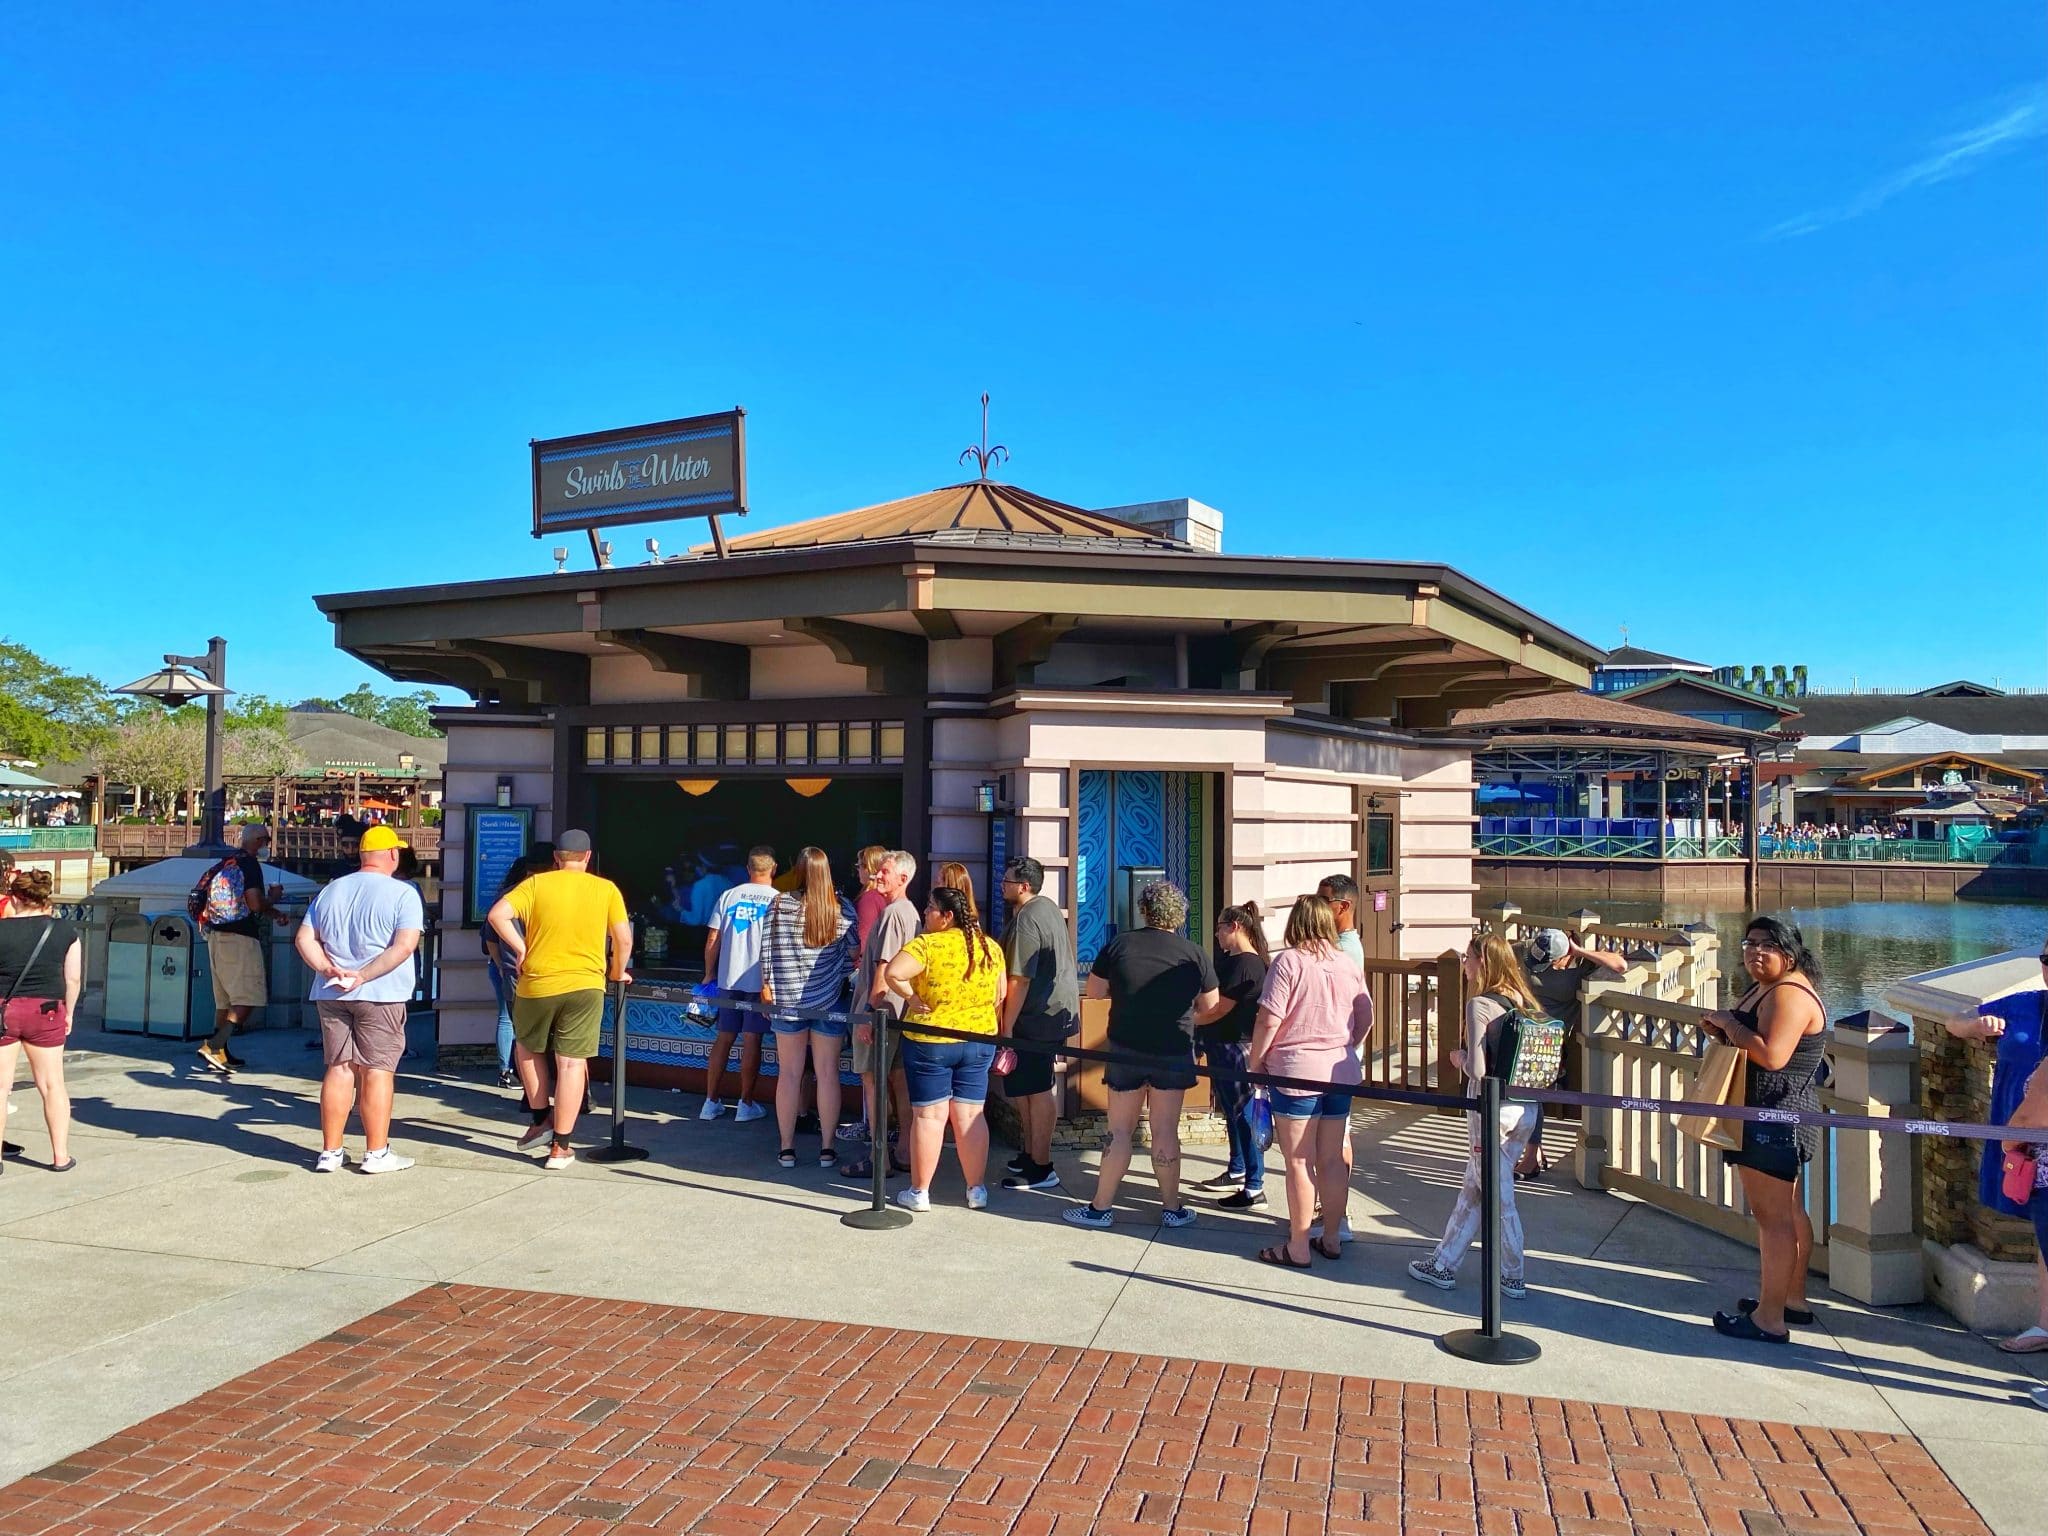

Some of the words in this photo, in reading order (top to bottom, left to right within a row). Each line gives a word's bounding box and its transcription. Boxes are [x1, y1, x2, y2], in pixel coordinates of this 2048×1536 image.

[564, 460, 627, 499] Swirls
[641, 453, 711, 487] Water
[1621, 1099, 1661, 1112] SPRINGS
[1758, 1111, 1801, 1124] SPRINGS
[1905, 1123, 1950, 1136] SPRINGS
